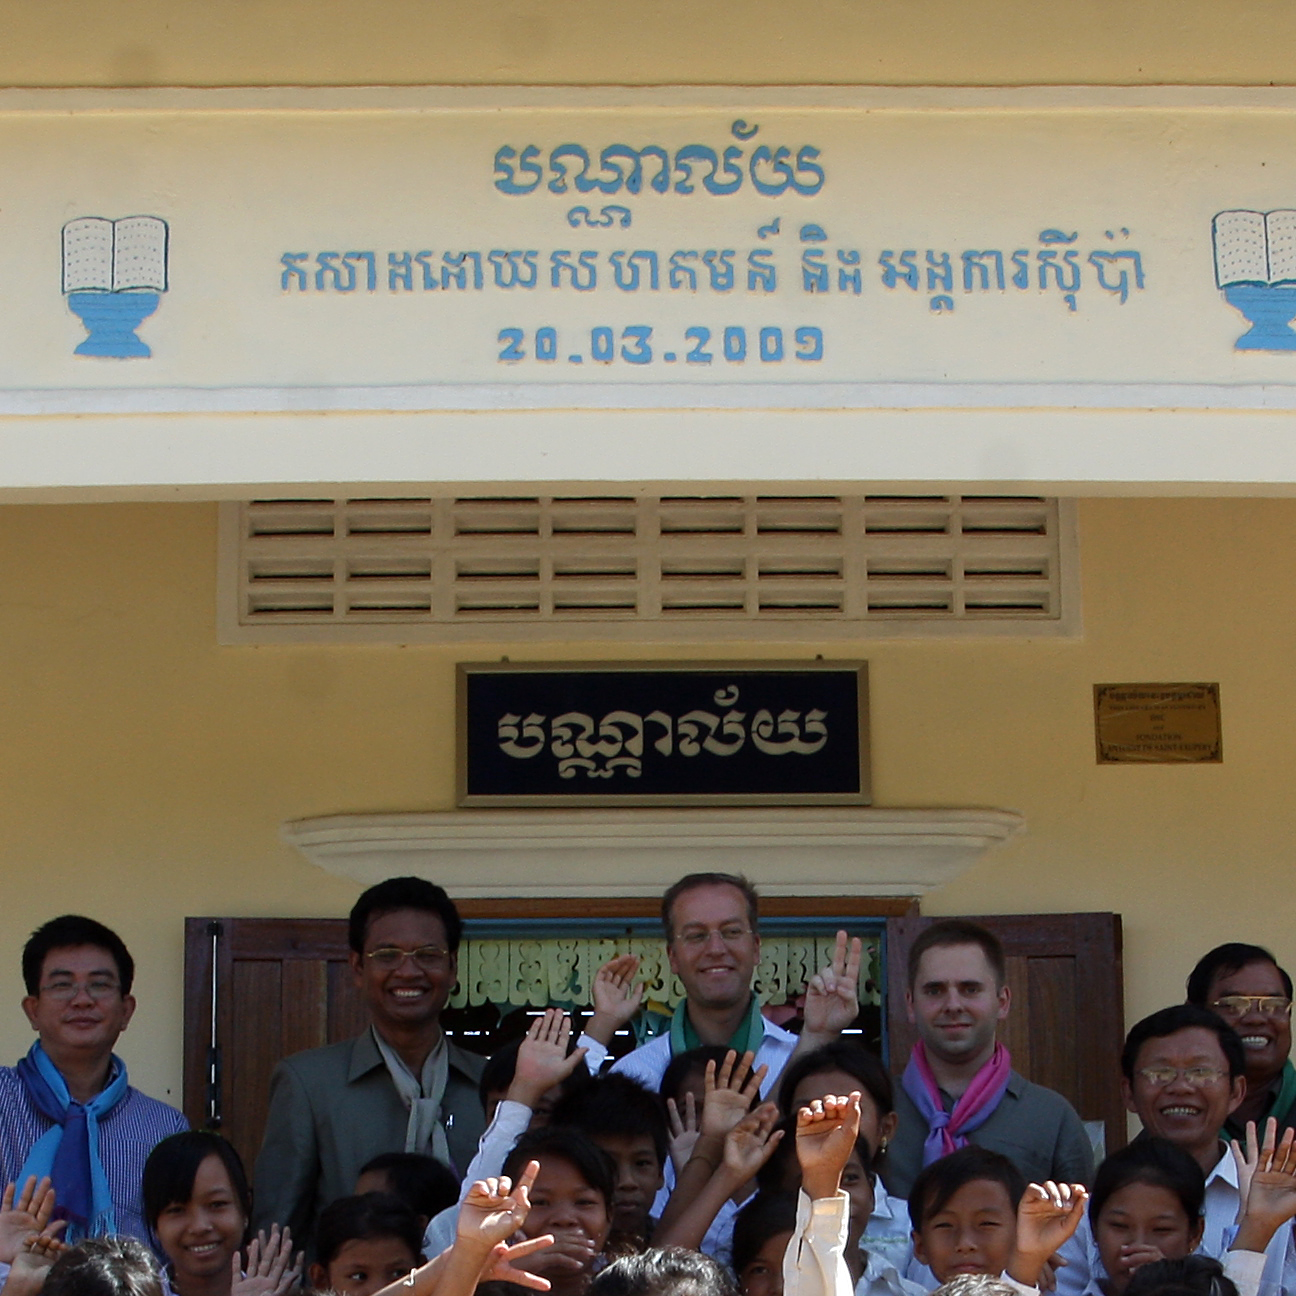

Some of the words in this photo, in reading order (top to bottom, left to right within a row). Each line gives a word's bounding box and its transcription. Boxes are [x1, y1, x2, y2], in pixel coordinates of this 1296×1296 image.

[493, 119, 826, 229] បណ្ណាល័យ
[798, 223, 862, 294] និង
[497, 325, 825, 364] 20.03.2009
[497, 684, 829, 780] បណ្ណាល័យ
